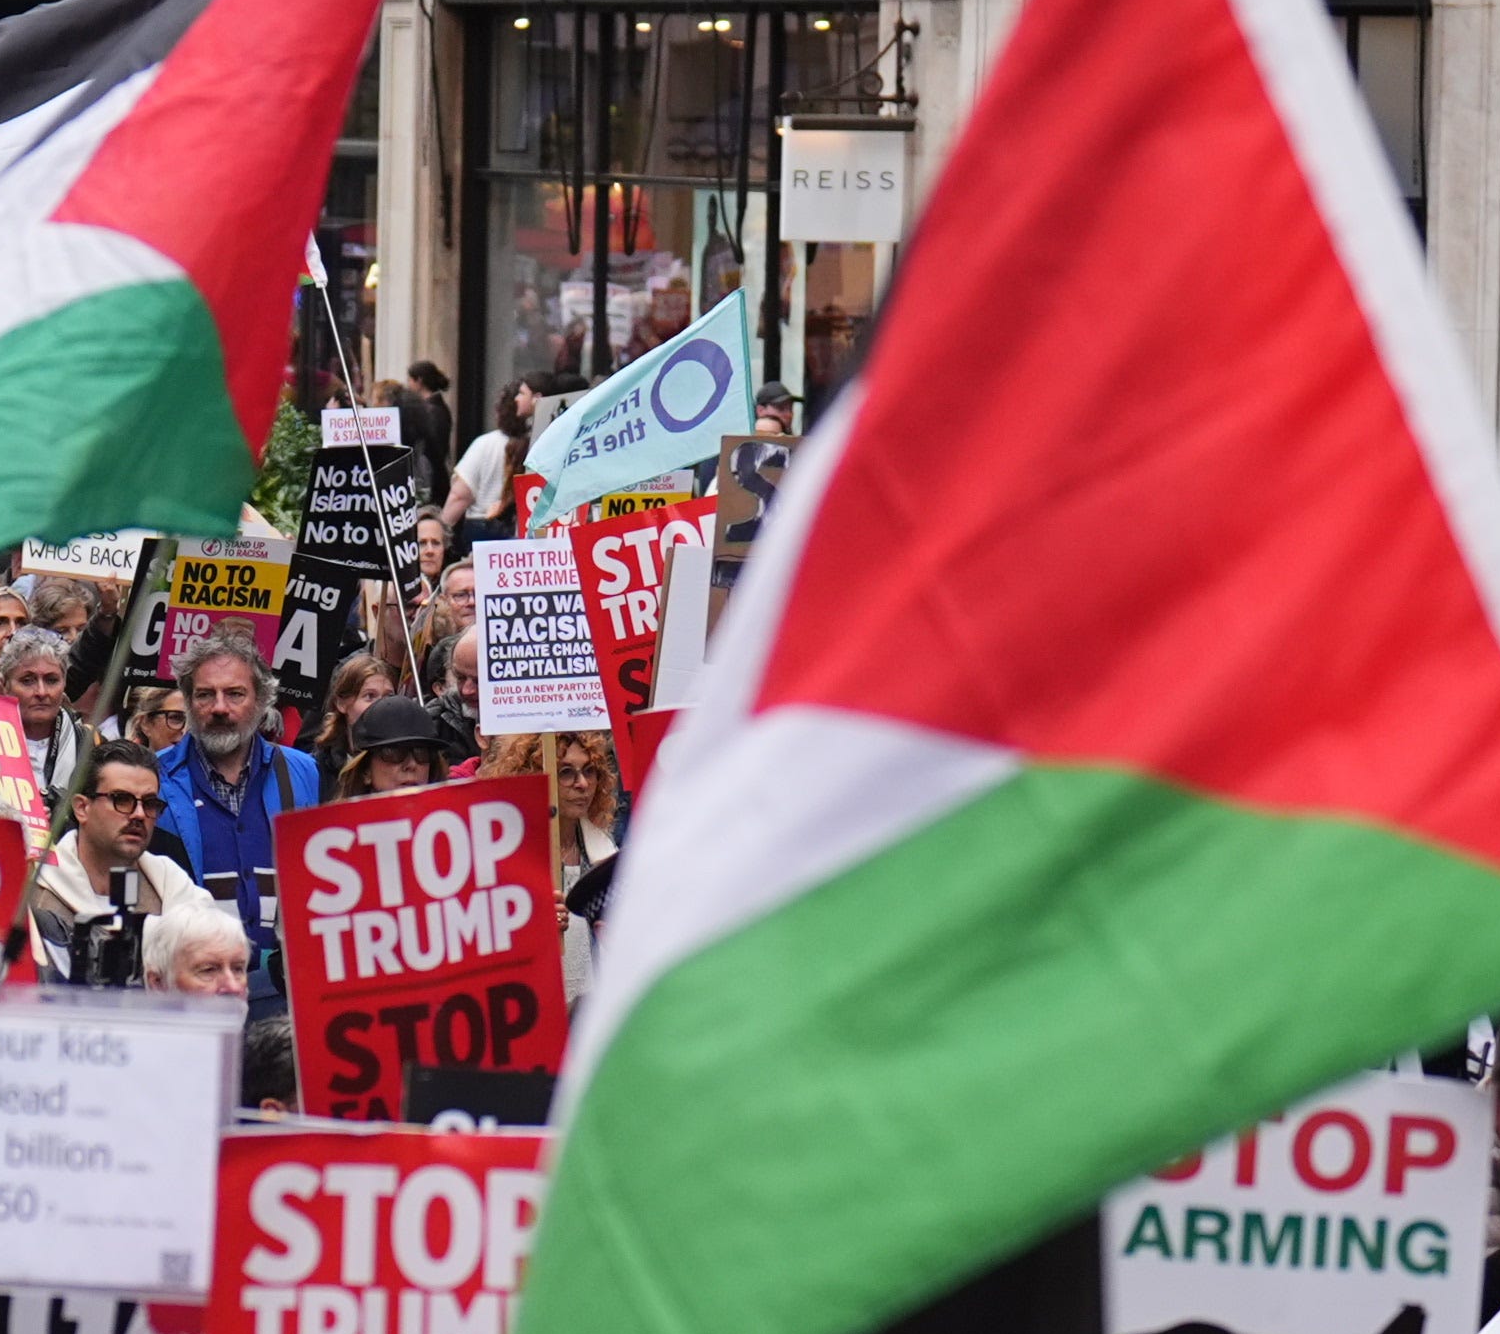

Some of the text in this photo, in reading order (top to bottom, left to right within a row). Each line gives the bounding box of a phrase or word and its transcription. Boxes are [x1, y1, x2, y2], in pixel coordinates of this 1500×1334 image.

[792, 170, 898, 190] REISS
[90, 547, 136, 568] BACK
[492, 696, 514, 704] GIVE
[517, 694, 564, 703] STUDENTS
[567, 693, 573, 701] A
[494, 686, 522, 694] BUILD
[558, 683, 586, 691] PARTY
[303, 800, 526, 915] STOP
[308, 885, 532, 984] TRUMP
[58, 1027, 130, 1067] kids
[4, 1129, 113, 1171] billion
[1123, 1205, 1453, 1276] ARMING
